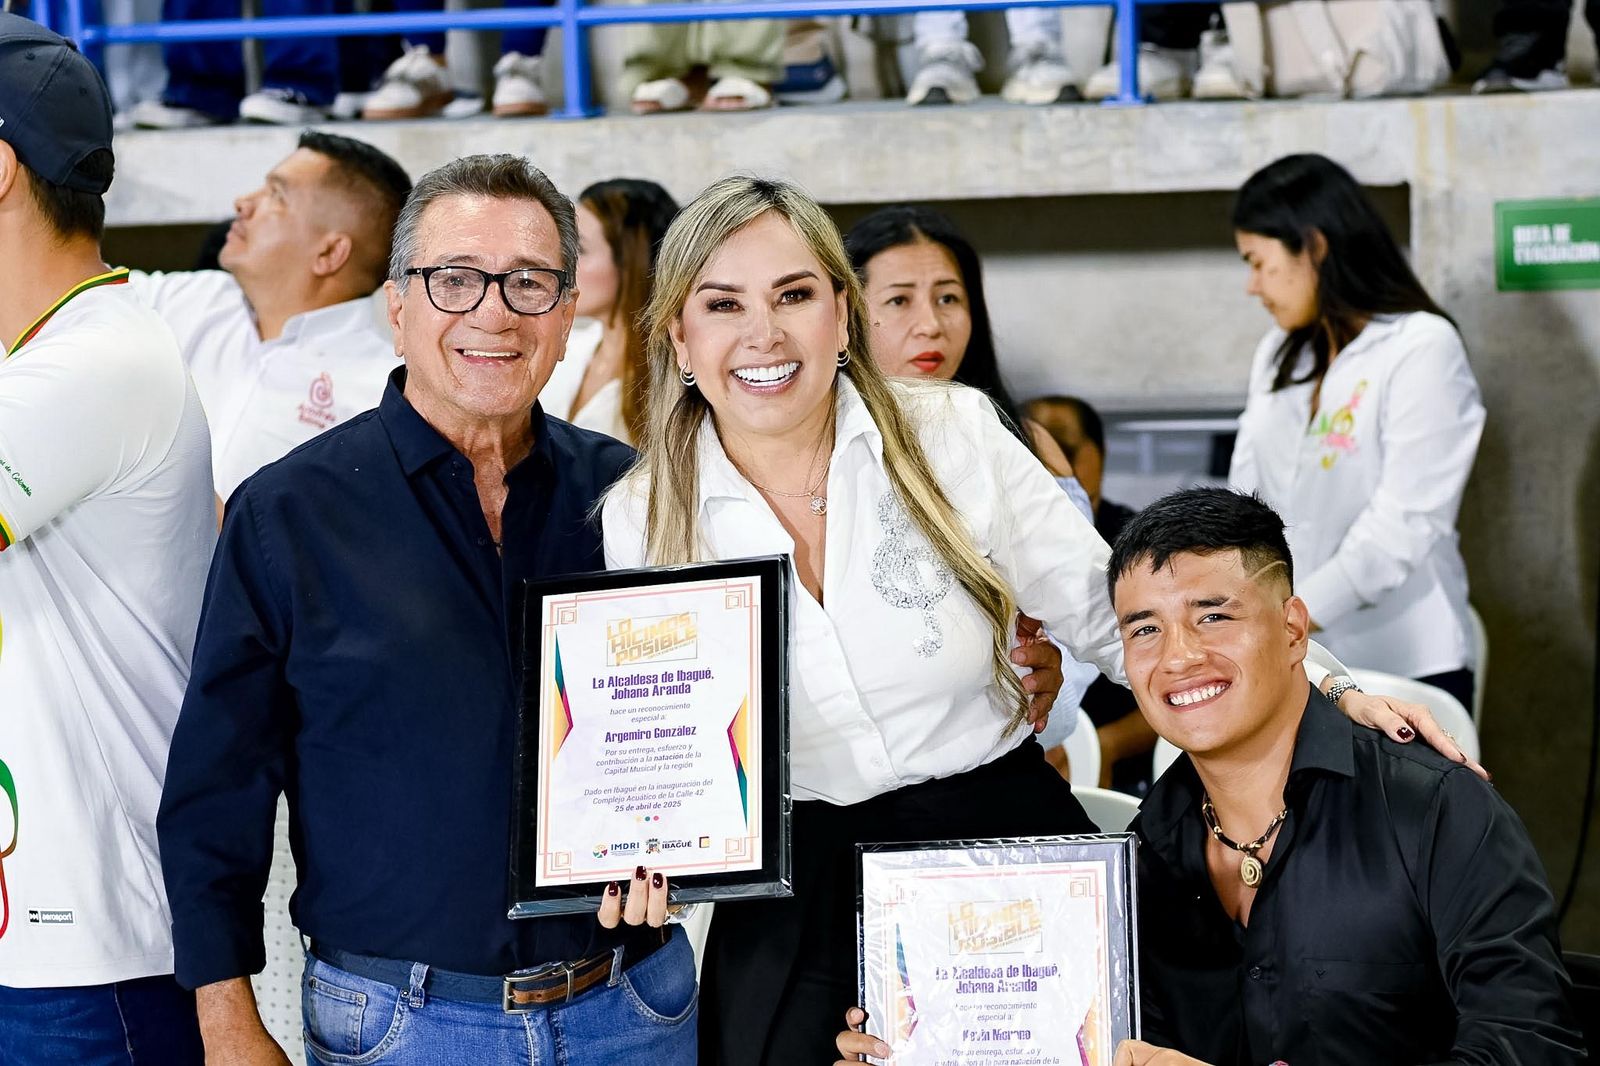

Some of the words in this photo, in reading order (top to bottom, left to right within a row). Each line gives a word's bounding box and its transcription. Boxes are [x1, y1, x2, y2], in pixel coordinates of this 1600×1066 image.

[12, 472, 32, 496] Colombia
[607, 618, 631, 640] LO
[616, 624, 697, 666] POSIBLE
[592, 678, 604, 690] La
[608, 674, 658, 688] Alcaldesa
[662, 672, 674, 683] de
[612, 687, 649, 700] Johana
[652, 682, 691, 696] Aranda
[610, 708, 626, 716] hace
[638, 702, 690, 712] reconocimiento
[631, 714, 659, 723] especial
[605, 728, 652, 744] Argemiro
[654, 725, 697, 738] González
[658, 744, 687, 753] esfuerzo
[596, 757, 638, 766] contribución
[654, 752, 684, 762] natación
[604, 766, 628, 776] Capital
[630, 764, 656, 773] Musical
[671, 761, 693, 770] región
[584, 788, 602, 796] Dado
[656, 780, 701, 790] inauguración
[592, 796, 625, 805] Complejo
[626, 792, 656, 802] Acuático
[658, 792, 667, 800] de
[668, 791, 674, 799] la
[676, 790, 694, 798] Calle
[694, 788, 704, 796] 42
[614, 804, 624, 812] 25
[626, 803, 634, 812] de
[636, 802, 652, 810] abril
[652, 801, 662, 809] de
[663, 800, 682, 808] 2025
[610, 842, 640, 850] IMDRI
[662, 840, 692, 850] IBAGUÉ
[1006, 965, 1020, 978] de
[956, 980, 994, 994] Johana
[977, 1013, 1006, 1022] especial
[1005, 1048, 1035, 1056] esfuo
[1036, 1048, 1042, 1056] y
[1052, 1056, 1060, 1064] la
